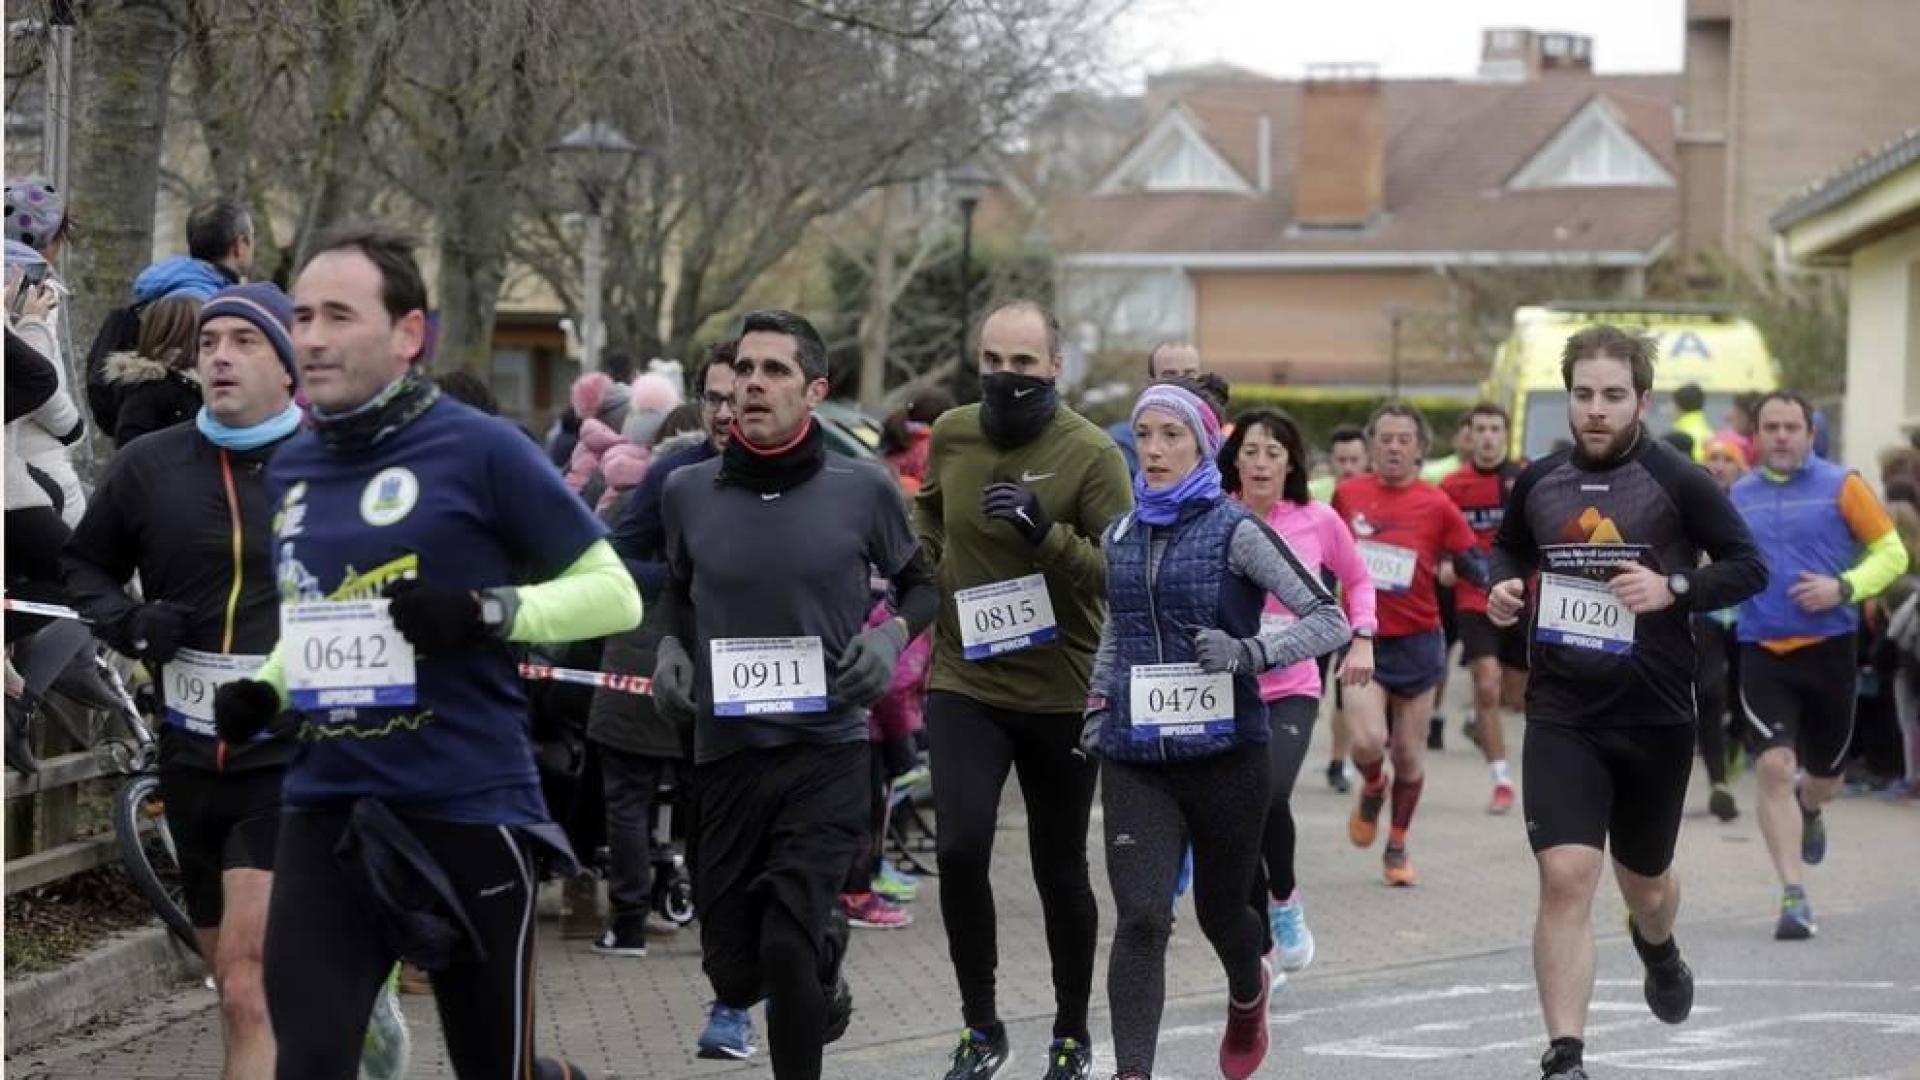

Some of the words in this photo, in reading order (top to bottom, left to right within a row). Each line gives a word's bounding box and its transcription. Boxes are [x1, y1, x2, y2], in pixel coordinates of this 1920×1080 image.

[975, 599, 1035, 632] 0815
[1560, 597, 1618, 628] 1020
[304, 634, 388, 671] 0642
[733, 660, 803, 688] 0911
[1149, 685, 1216, 712] 0476
